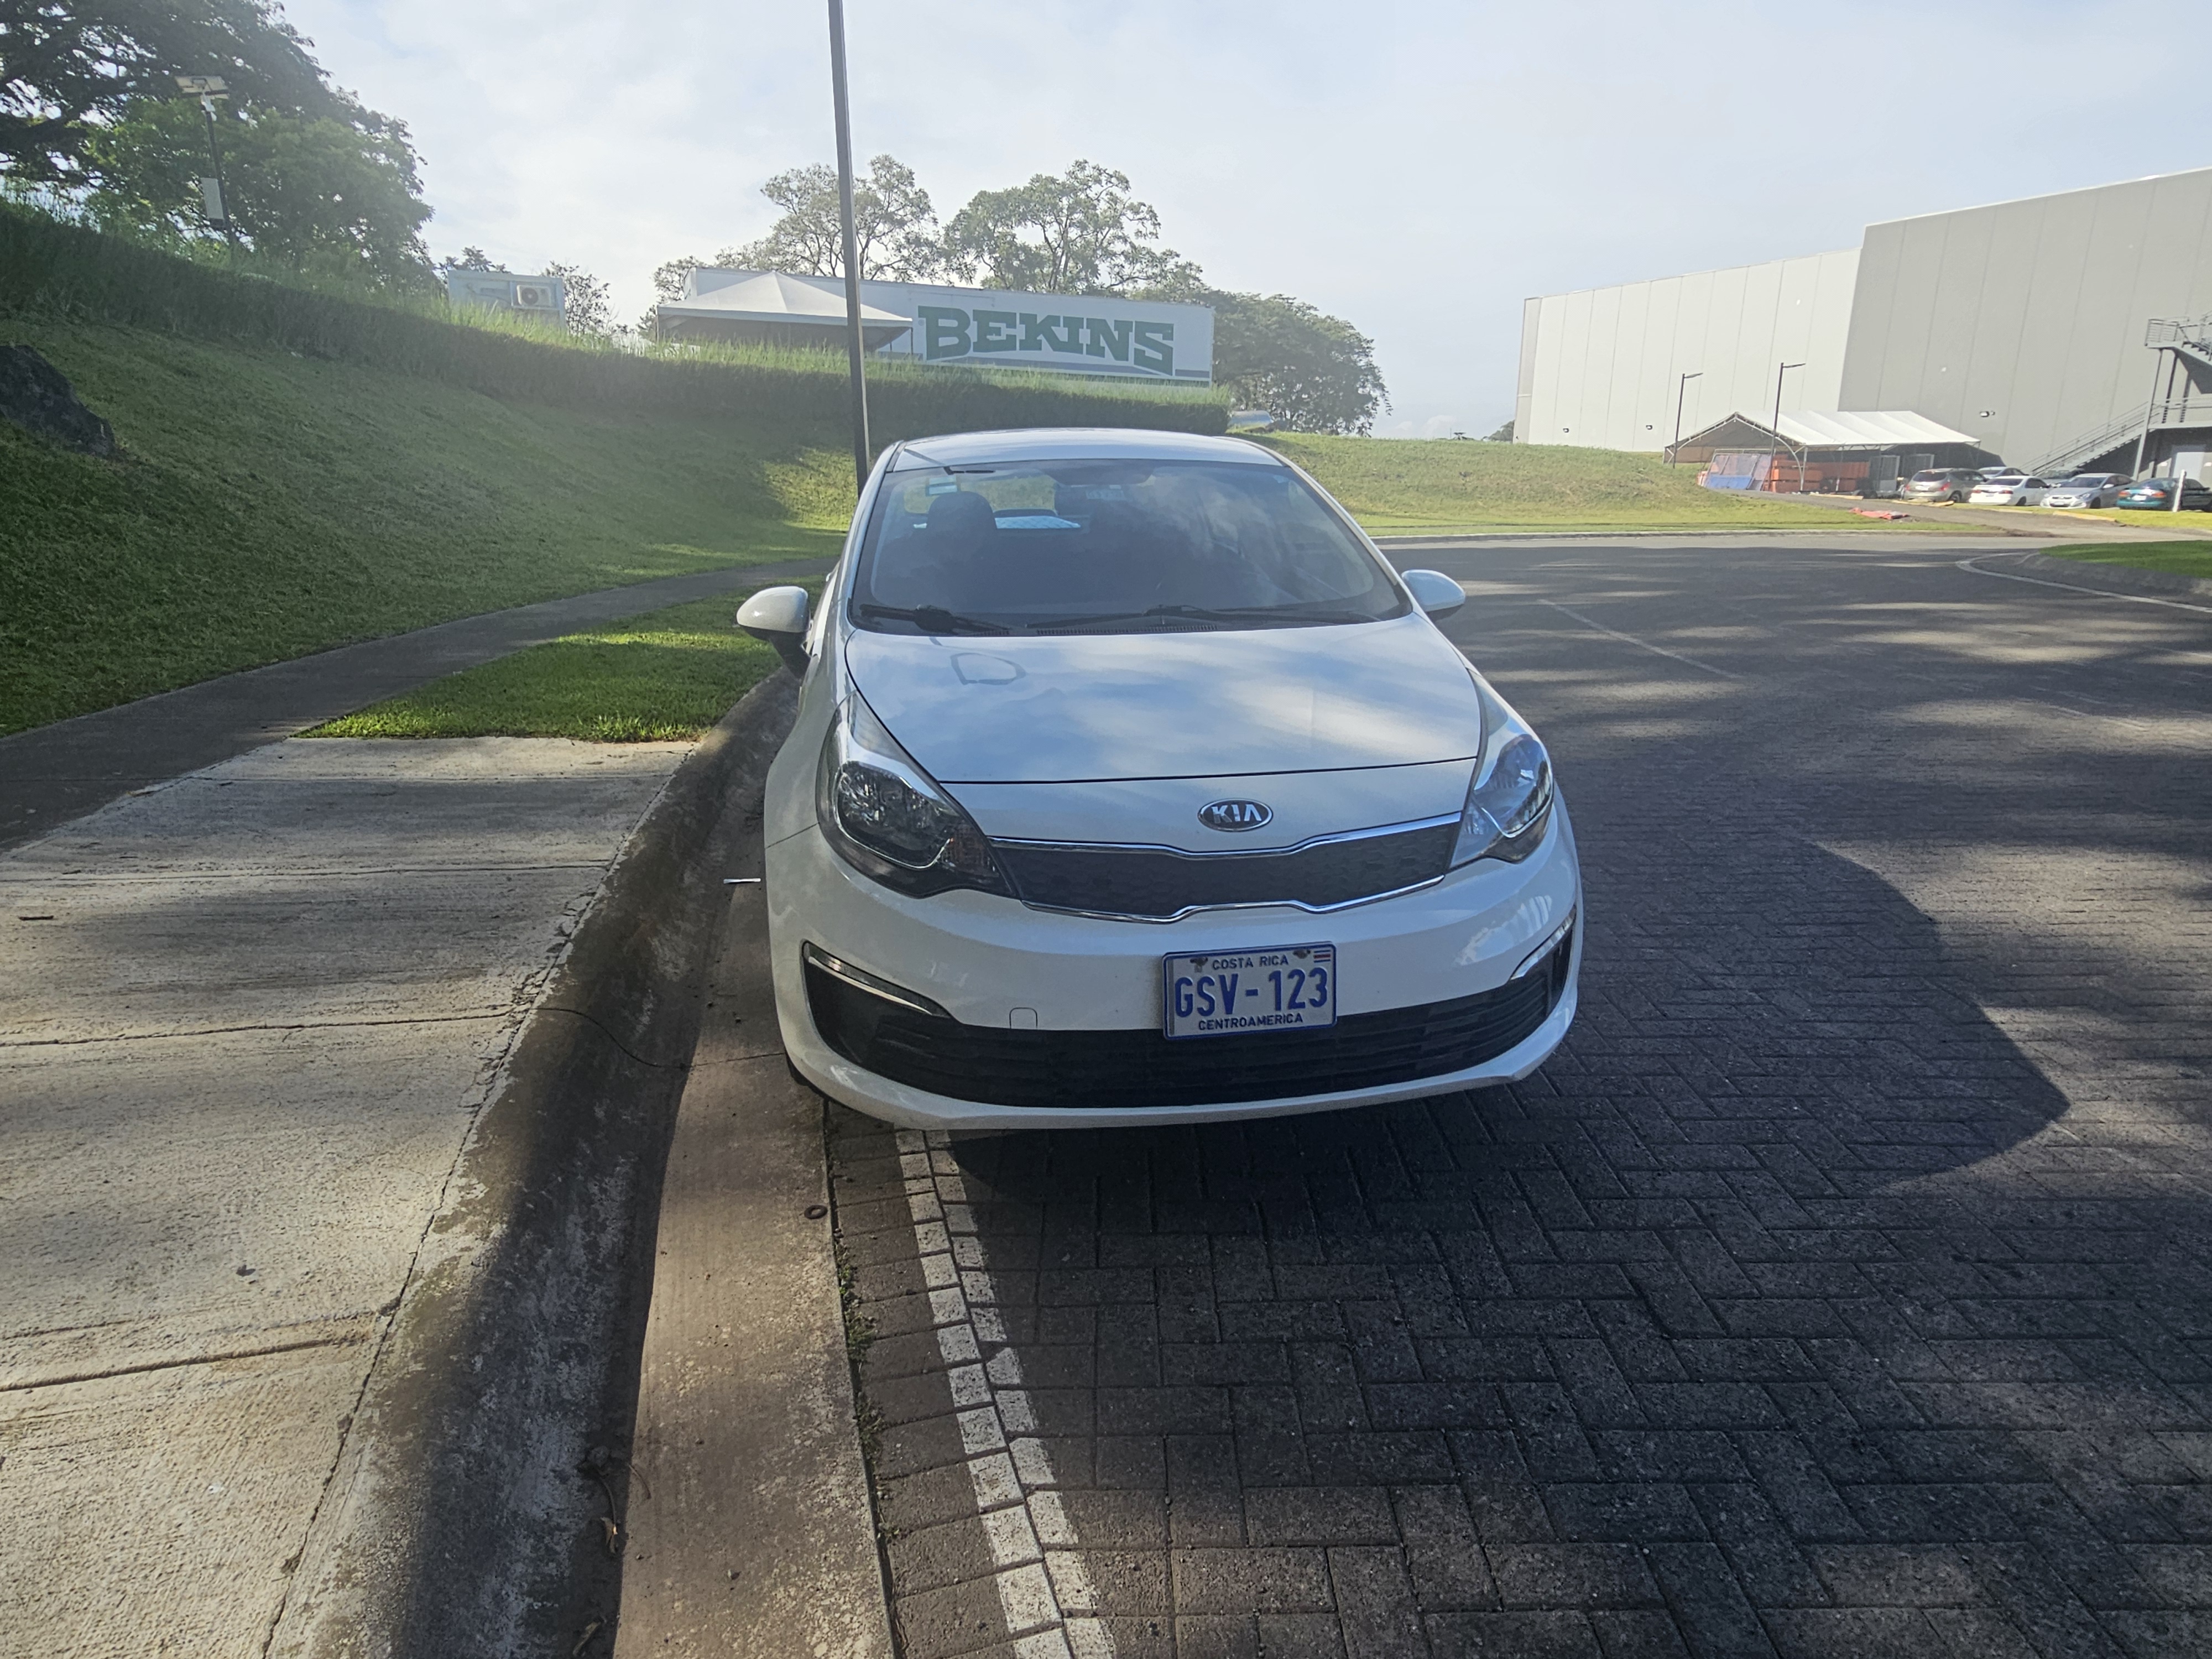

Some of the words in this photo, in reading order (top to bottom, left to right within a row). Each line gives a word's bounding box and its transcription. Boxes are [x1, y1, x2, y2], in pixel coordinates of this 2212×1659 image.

[917, 305, 1175, 377] BEKINS
[1211, 804, 1262, 823] KIA
[1212, 957, 1254, 970] COSTA
[1259, 954, 1289, 967] RICA
[1175, 967, 1328, 1018] GSV-123
[1198, 1013, 1303, 1031] CENTROAMERICA
